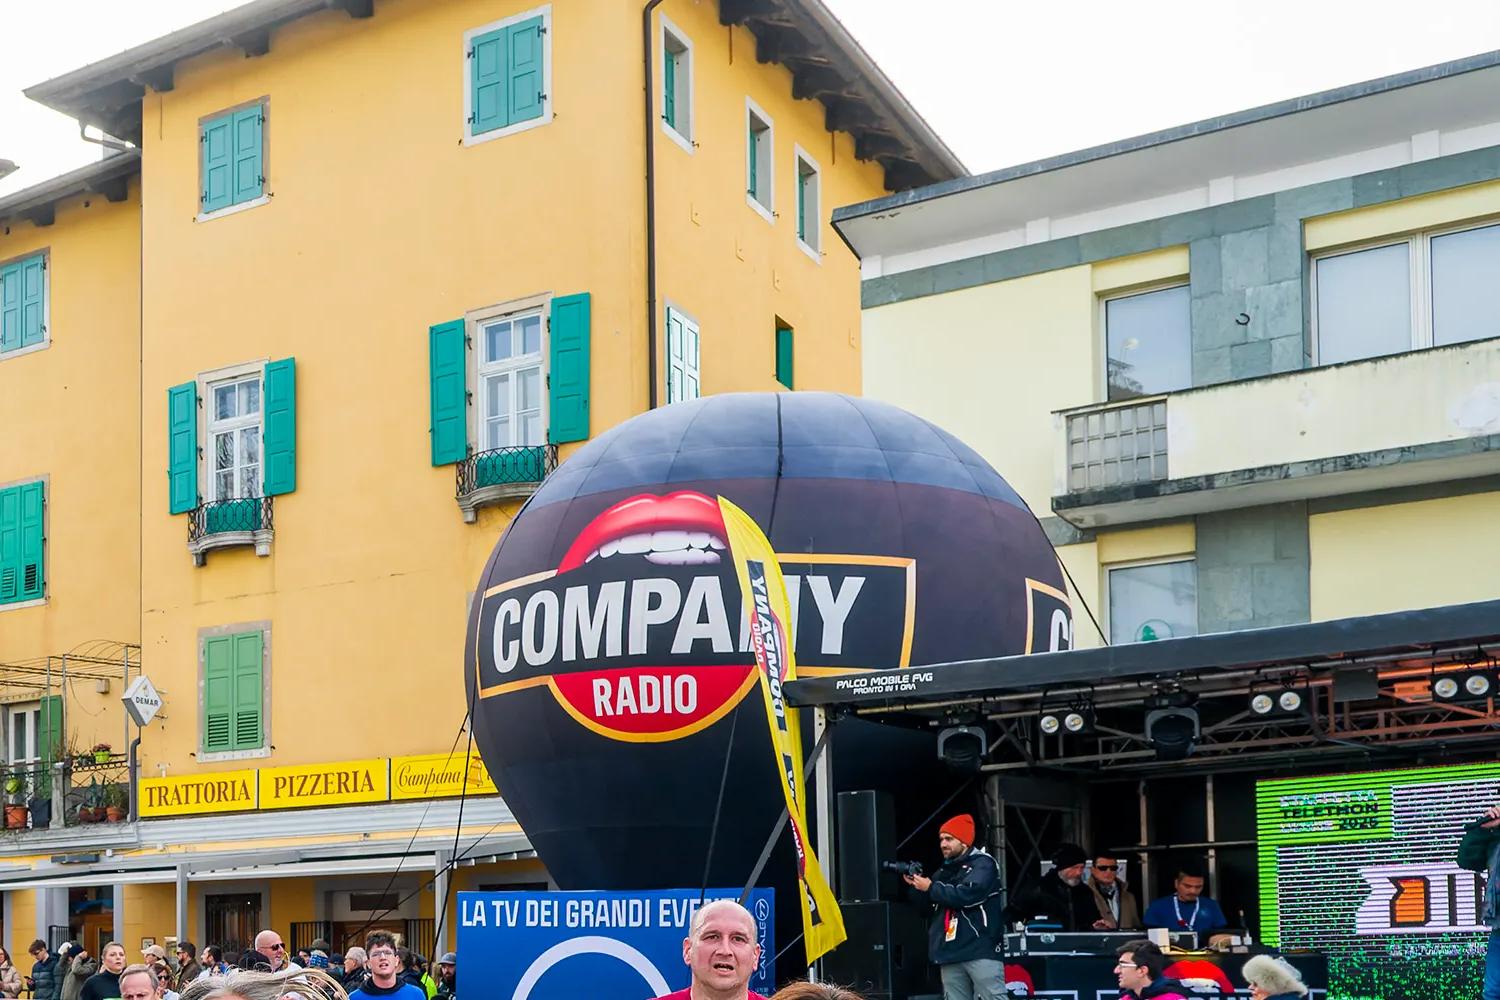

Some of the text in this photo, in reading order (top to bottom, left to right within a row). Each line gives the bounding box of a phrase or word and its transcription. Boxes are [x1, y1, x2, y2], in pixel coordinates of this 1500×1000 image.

[592, 674, 697, 717] RADIO
[836, 673, 933, 690] PALCO MOBILE FVG
[853, 686, 883, 695] PRONTO
[900, 683, 916, 691] ORA
[145, 769, 375, 808] TRATTORIA PIZZERIA
[399, 765, 461, 794] Campana
[1279, 803, 1379, 818] TELETHON
[462, 899, 650, 927] LA TV DEI GRANDI
